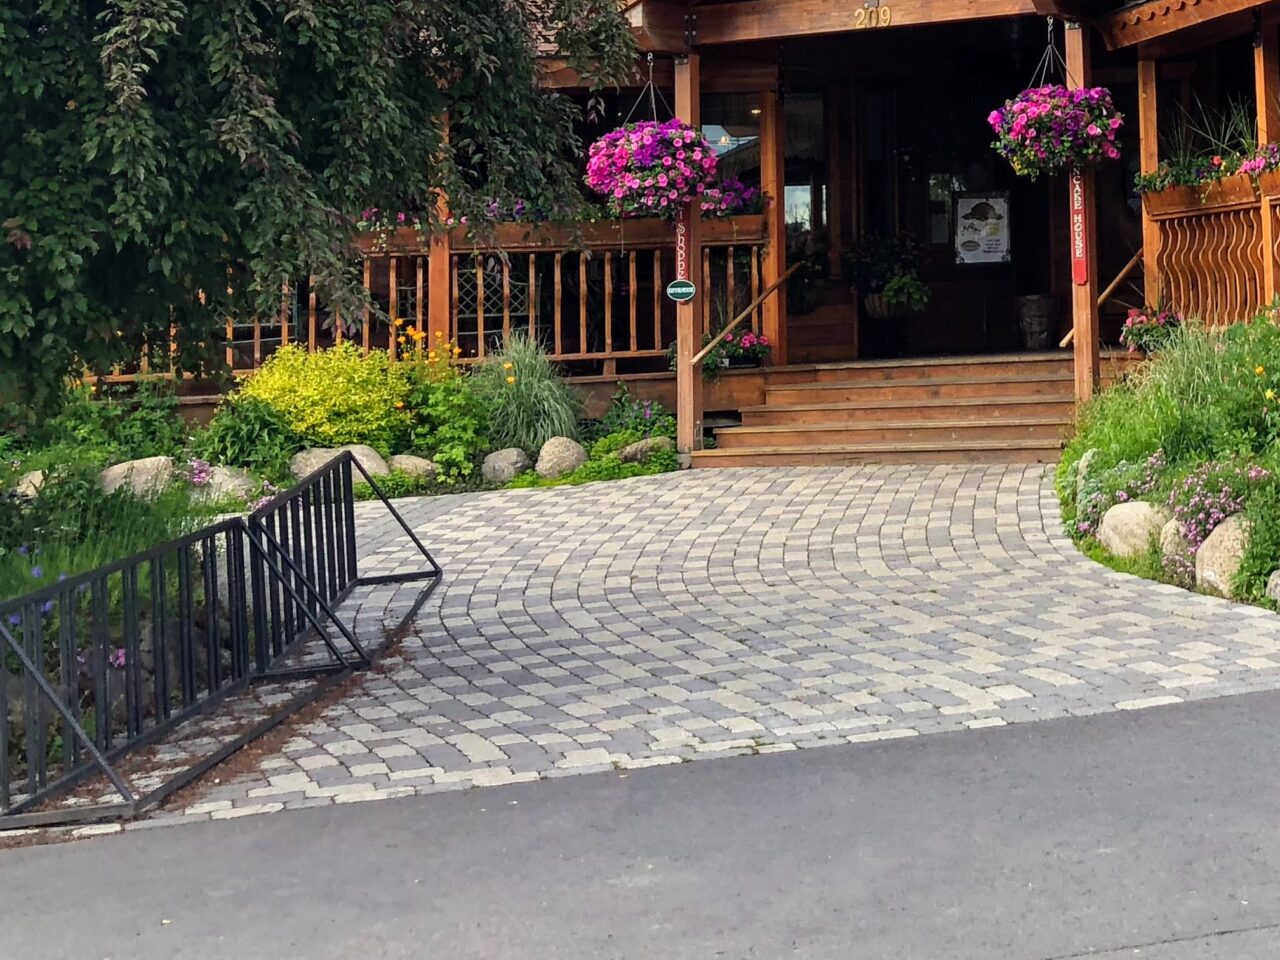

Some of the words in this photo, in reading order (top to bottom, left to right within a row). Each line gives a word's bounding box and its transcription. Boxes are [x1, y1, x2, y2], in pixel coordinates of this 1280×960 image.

[855, 6, 891, 29] 209
[1073, 167, 1083, 209] NCAKE
[1073, 213, 1084, 258] HOUSE
